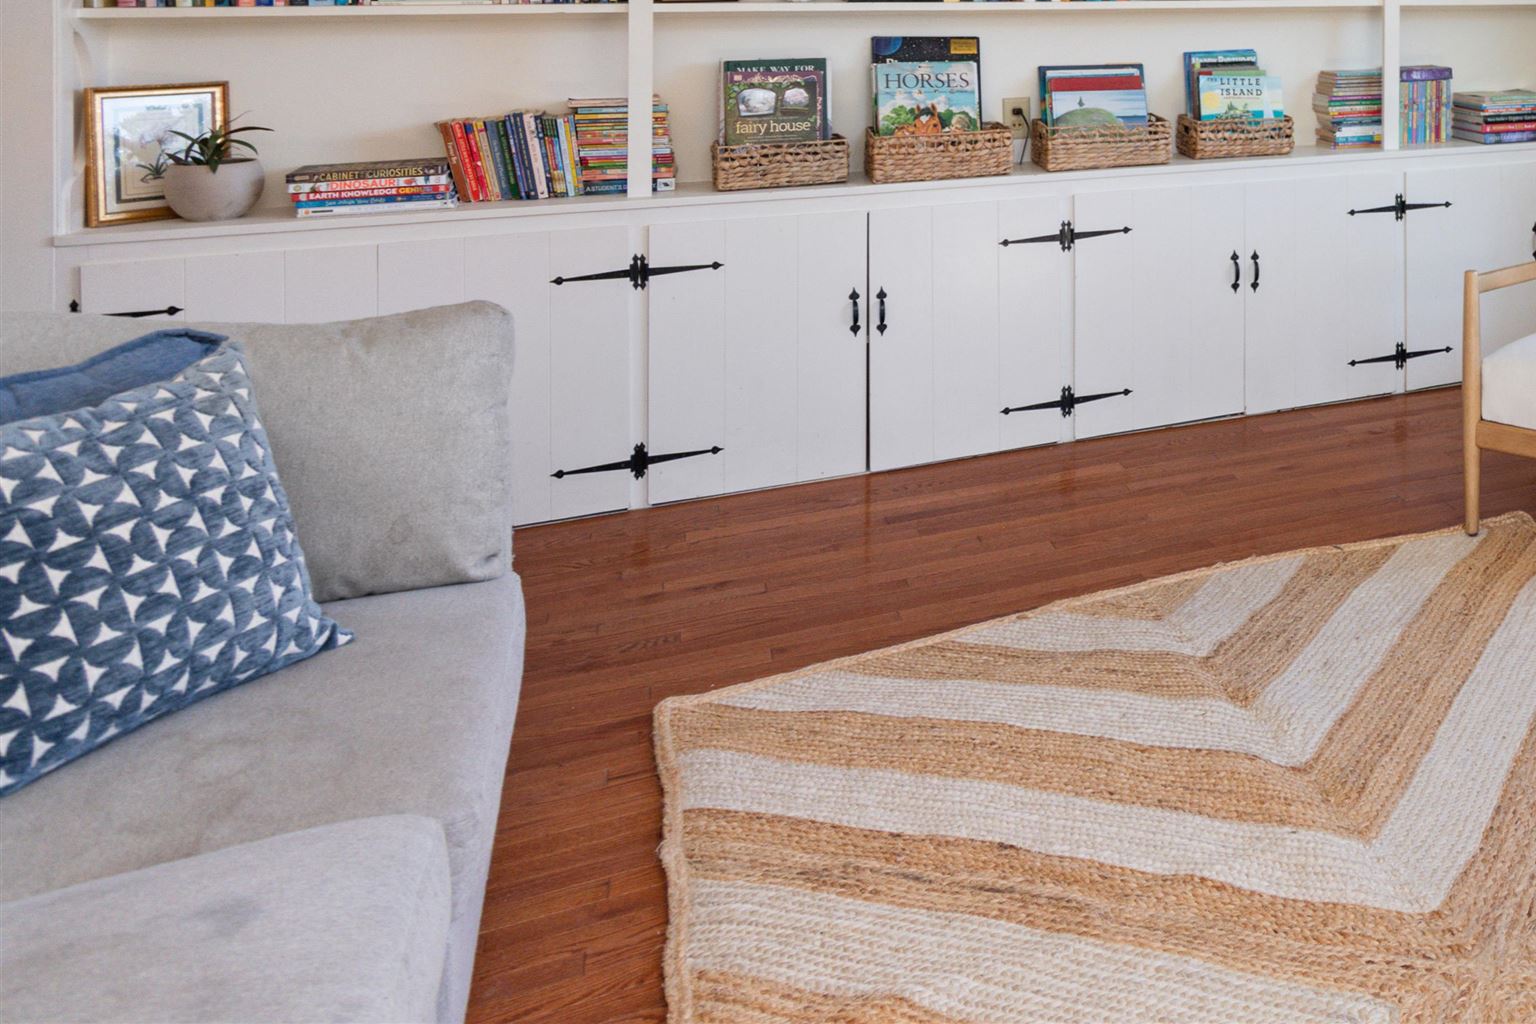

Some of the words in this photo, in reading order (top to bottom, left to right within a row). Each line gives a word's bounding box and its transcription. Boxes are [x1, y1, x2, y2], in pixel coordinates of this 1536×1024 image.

[884, 72, 970, 89] HORSES
[1219, 77, 1261, 86] LITTLE
[1220, 88, 1263, 97] ISLAND
[735, 121, 768, 135] fairy
[770, 120, 811, 132] house
[319, 172, 359, 181] CABINET
[367, 167, 423, 178] CURIOSITIES
[330, 179, 397, 190] DINOSAUR
[308, 191, 339, 201] EARTH
[340, 187, 397, 199] KNOWLEDGE
